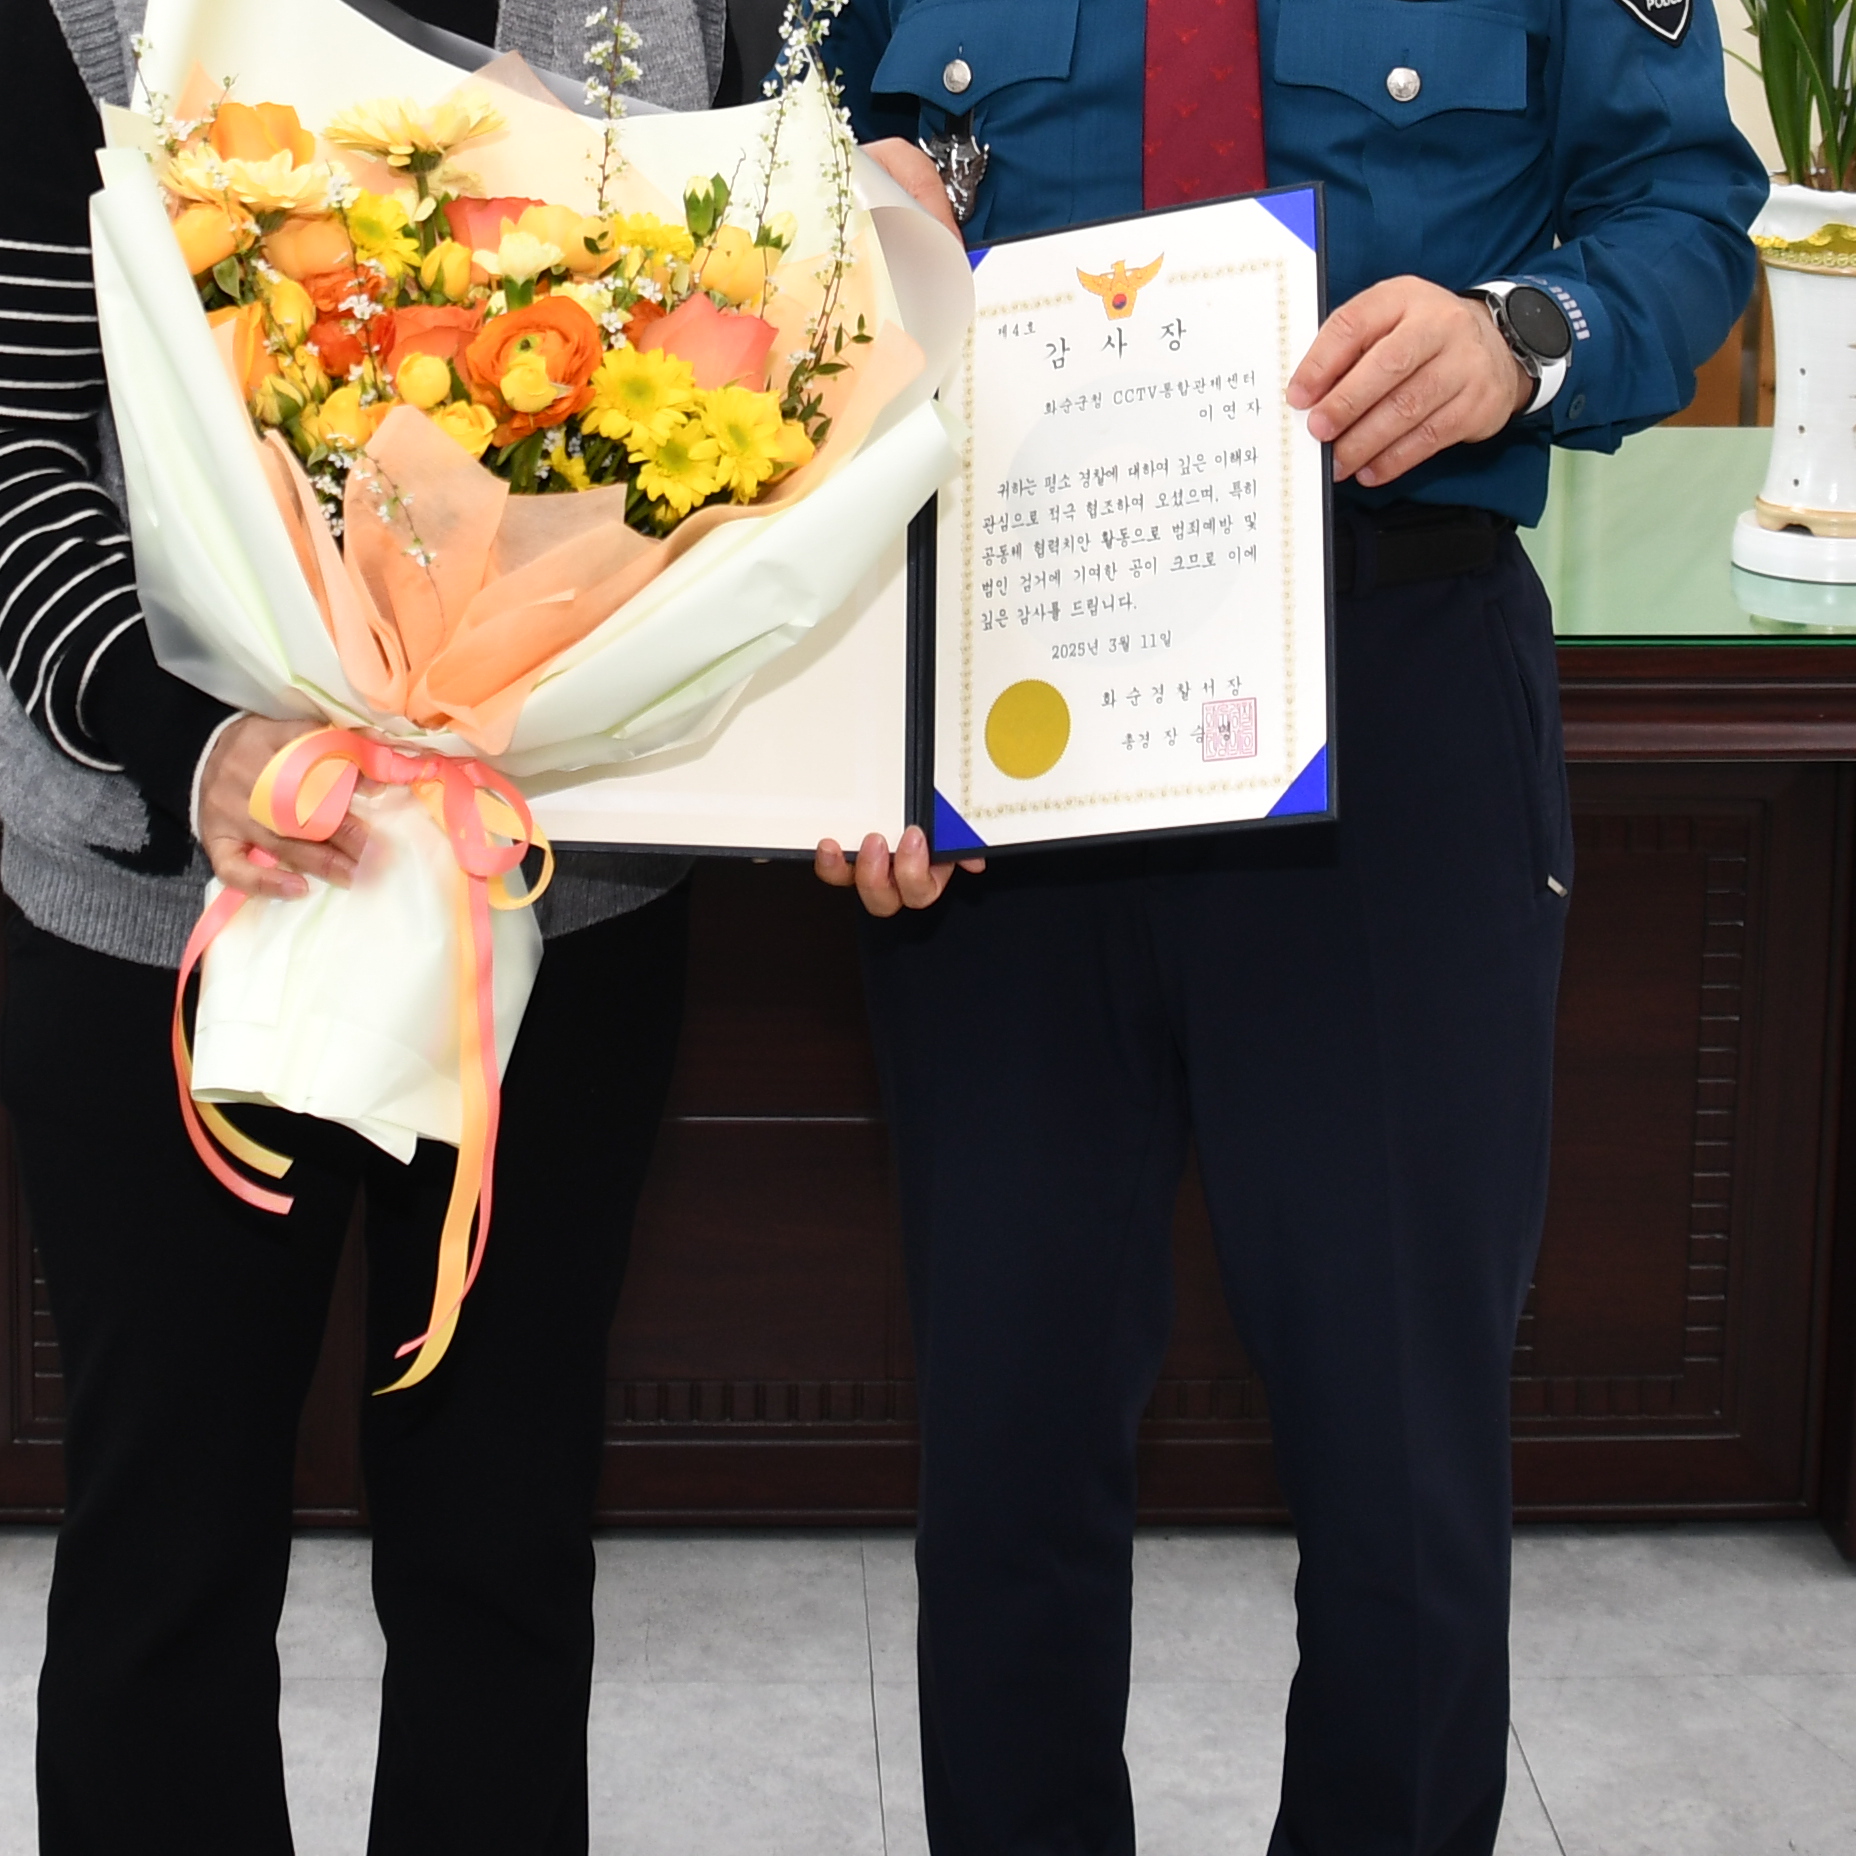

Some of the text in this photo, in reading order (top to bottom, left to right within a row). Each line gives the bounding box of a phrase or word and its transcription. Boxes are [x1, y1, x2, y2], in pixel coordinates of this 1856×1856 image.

[1044, 392, 1102, 415] 화순군청
[997, 446, 1258, 500] 귀하는 평소 경찰에 대하여 깊은 이해와
[982, 510, 1038, 534] 관심으로
[1049, 503, 1076, 523] 적극
[1086, 493, 1143, 519] 협조하여
[1229, 479, 1256, 500] 특히
[982, 511, 1256, 566] 공동체 협력치안 활동으로 범죄예방 및
[982, 544, 1256, 598] 범인 검거에 기여한 공이 크므로 이에
[982, 592, 1137, 631] 깊은 감사를 드립니다.
[1051, 630, 1172, 659] 2025년 3월 11일
